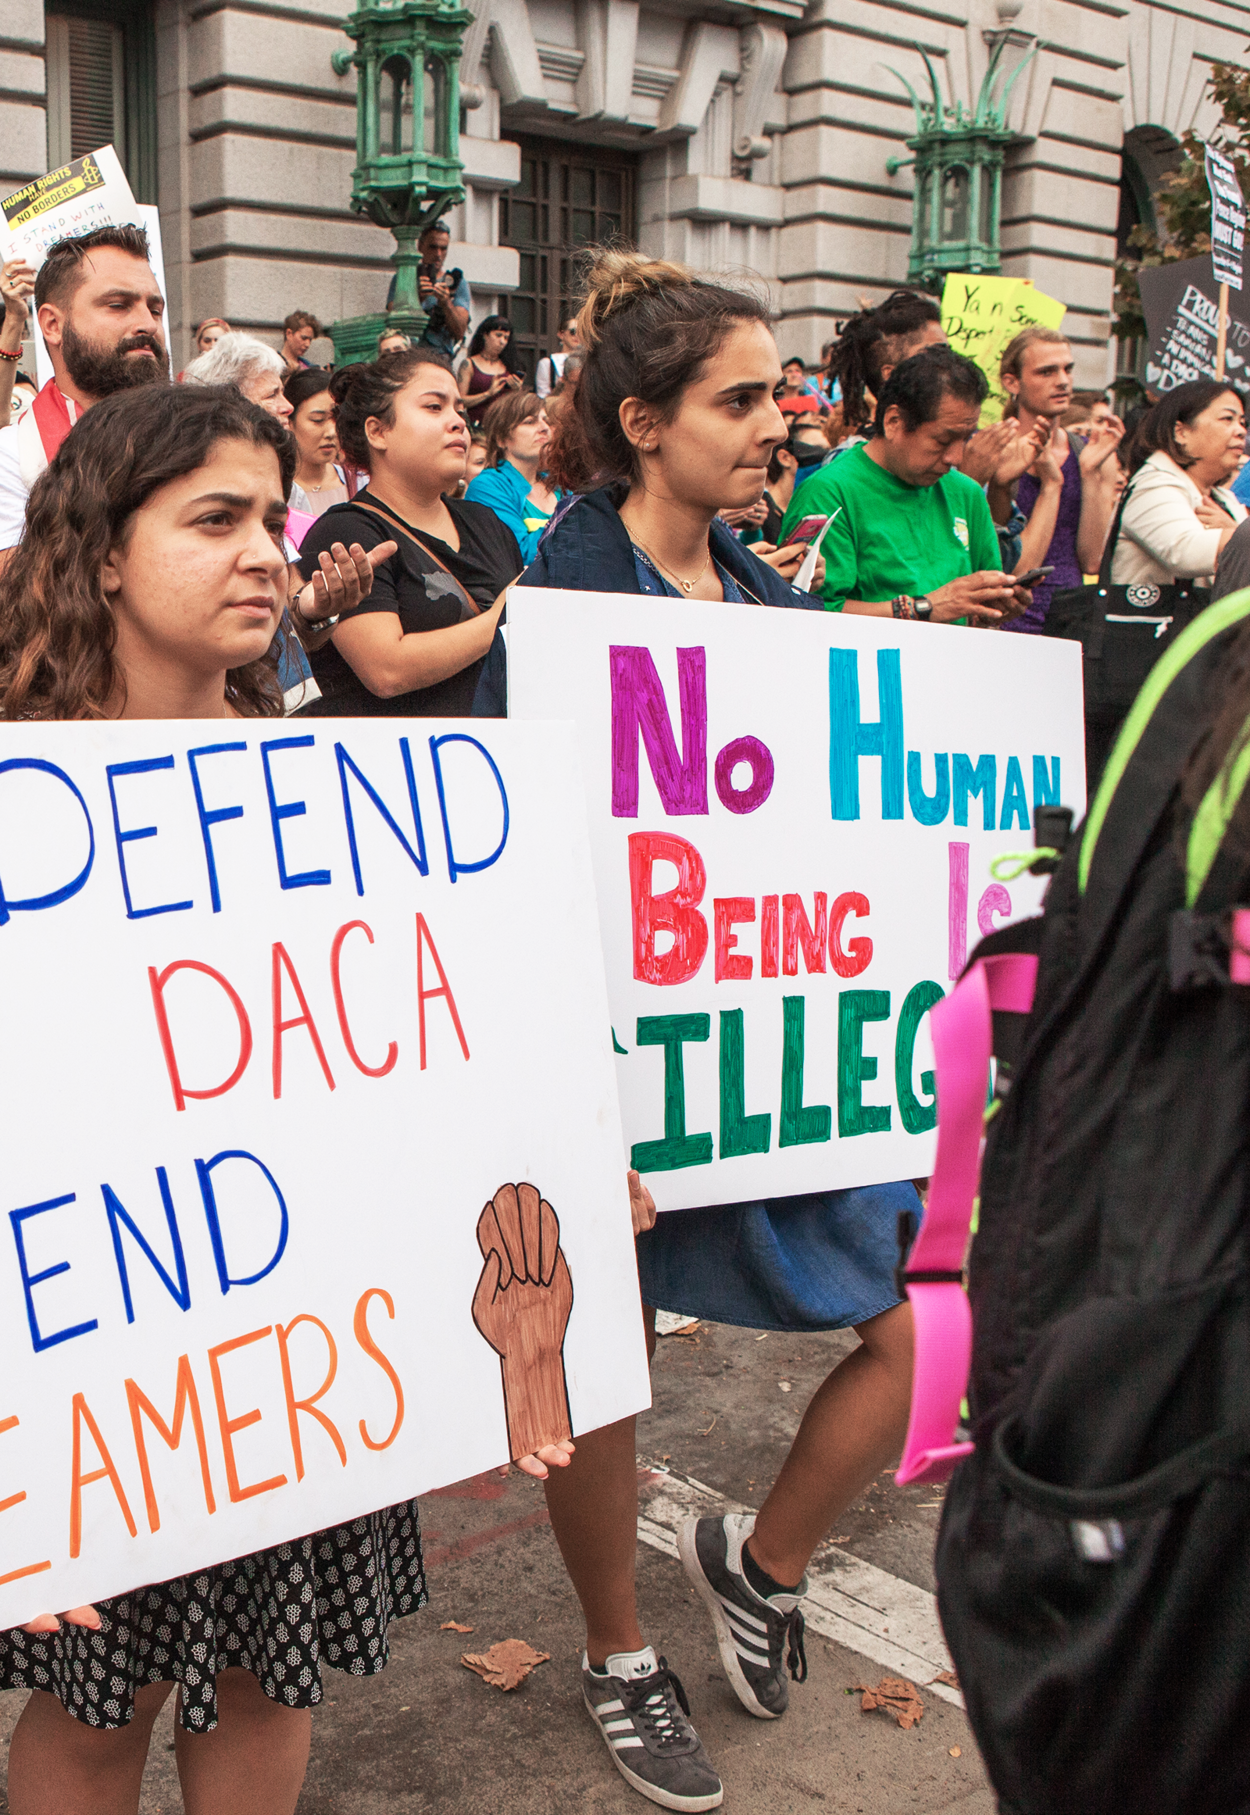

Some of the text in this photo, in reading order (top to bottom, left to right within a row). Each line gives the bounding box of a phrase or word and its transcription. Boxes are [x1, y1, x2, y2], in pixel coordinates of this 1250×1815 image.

[2, 166, 73, 211] HUMAN RIGHTS
[16, 210, 31, 224] NO
[31, 183, 76, 214] BORDERS
[23, 218, 66, 245] STAND
[70, 202, 105, 222] WITH
[147, 912, 471, 1112] DACA
[630, 979, 940, 1175] ILLEG
